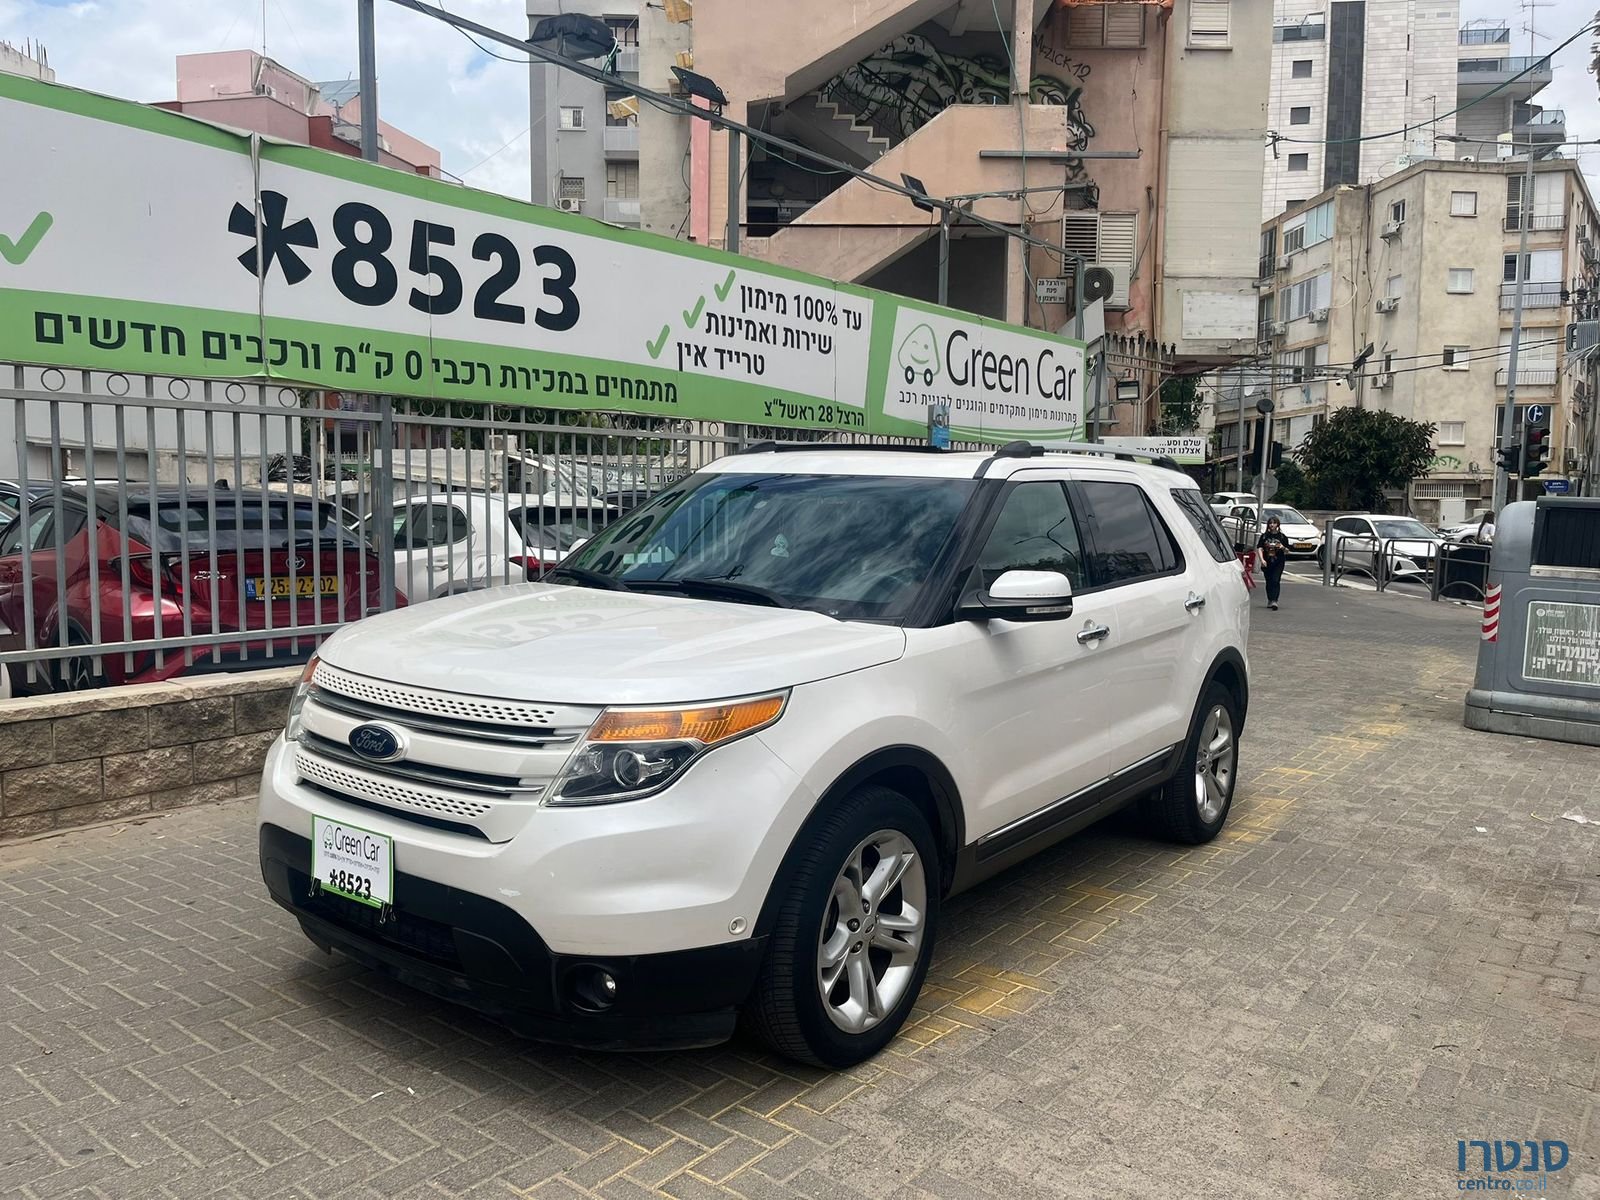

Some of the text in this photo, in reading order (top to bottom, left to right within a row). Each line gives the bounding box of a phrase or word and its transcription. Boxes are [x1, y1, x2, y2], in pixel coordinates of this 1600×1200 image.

[740, 284, 862, 331] עד 100% מימון
[34, 311, 186, 357] חדשים
[705, 311, 832, 355] שירות ואמינות
[202, 330, 321, 370] ורכבים
[405, 350, 423, 380] 0
[676, 341, 765, 376] טרייד אין
[946, 329, 1077, 401] Green Car
[431, 357, 491, 387] רכבי
[499, 364, 589, 395] במכירת
[595, 374, 678, 404] מתמחים
[899, 390, 917, 404] רכב
[764, 398, 865, 427] הרצל 28 ראשל"צ
[956, 399, 986, 413] והוגנים
[989, 403, 1026, 419] מתקדמים
[1028, 407, 1048, 420] מימון
[1050, 410, 1077, 424] פתרונות
[1532, 656, 1573, 673] נקייה!
[1546, 644, 1599, 660] שומרים
[356, 728, 388, 752] Ford
[334, 826, 362, 857] Green
[363, 835, 380, 862] Car
